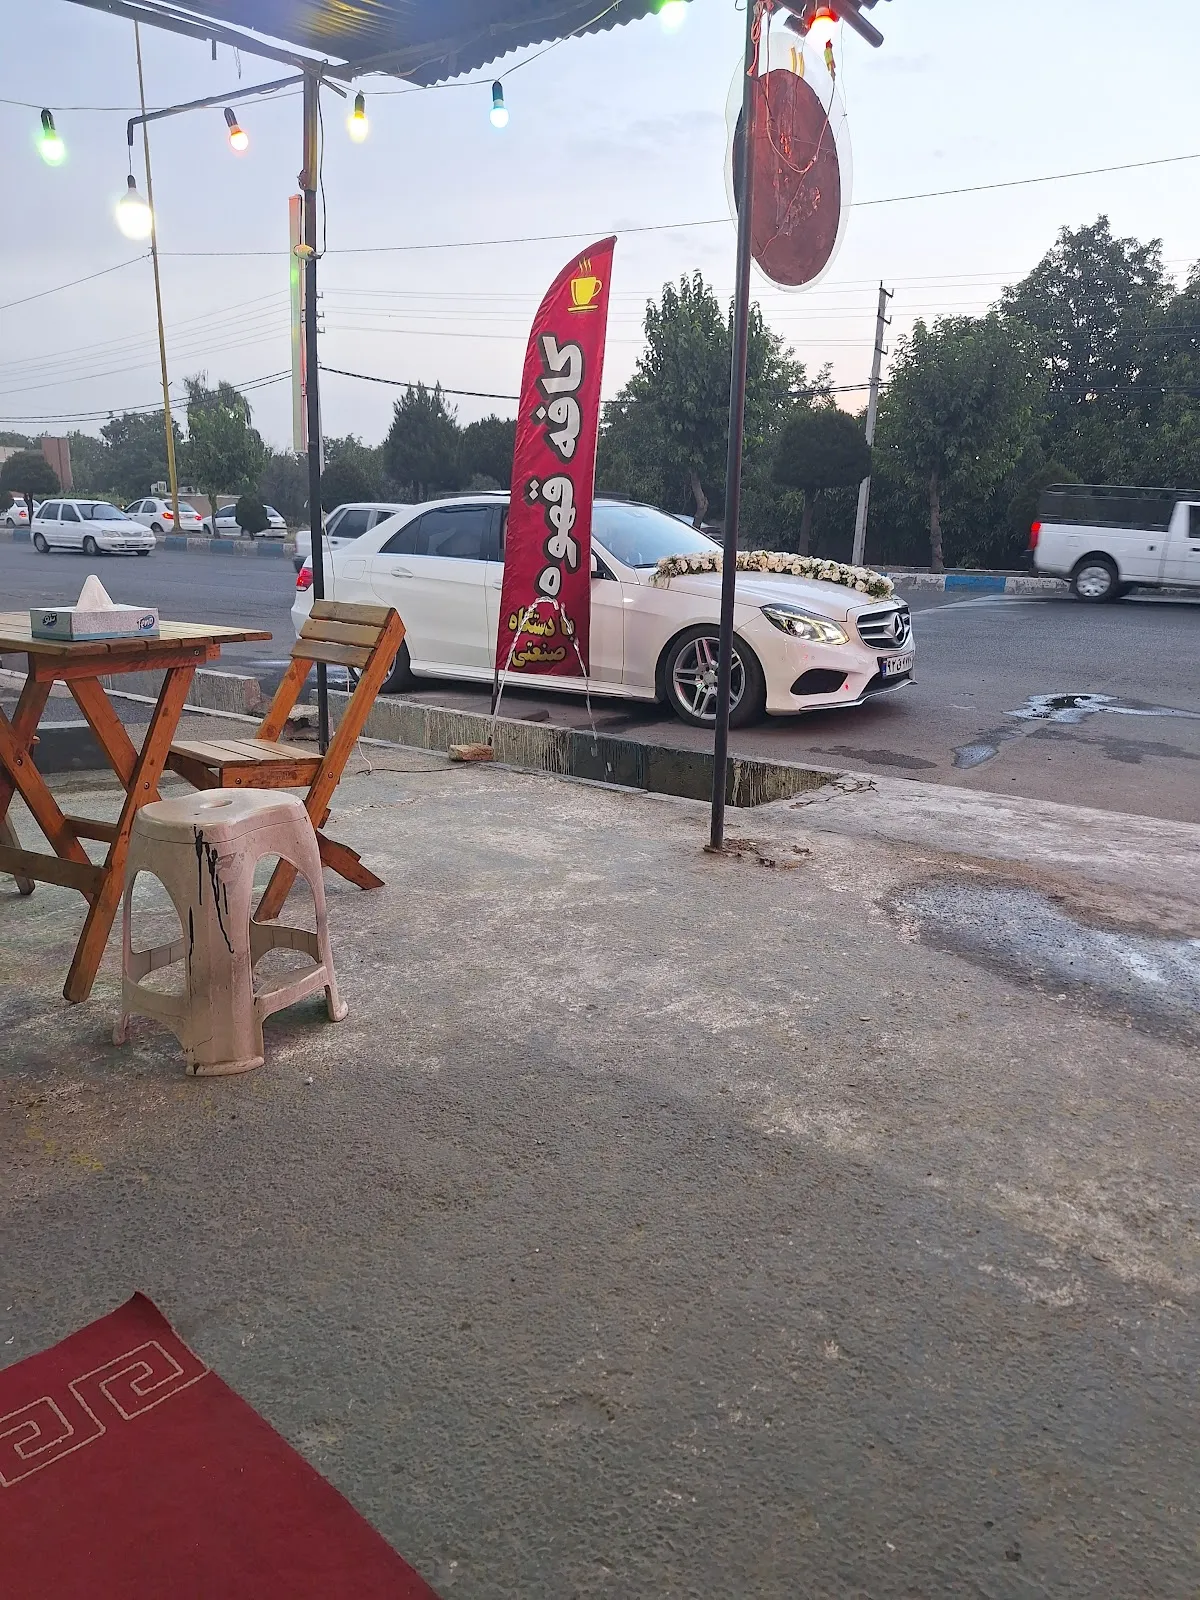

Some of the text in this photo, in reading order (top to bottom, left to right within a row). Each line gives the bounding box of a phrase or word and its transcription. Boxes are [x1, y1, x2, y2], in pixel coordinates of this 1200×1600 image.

[528, 335, 583, 599] کافه قهوه
[137, 616, 154, 630] Teno
[511, 641, 566, 667] صنعتی
